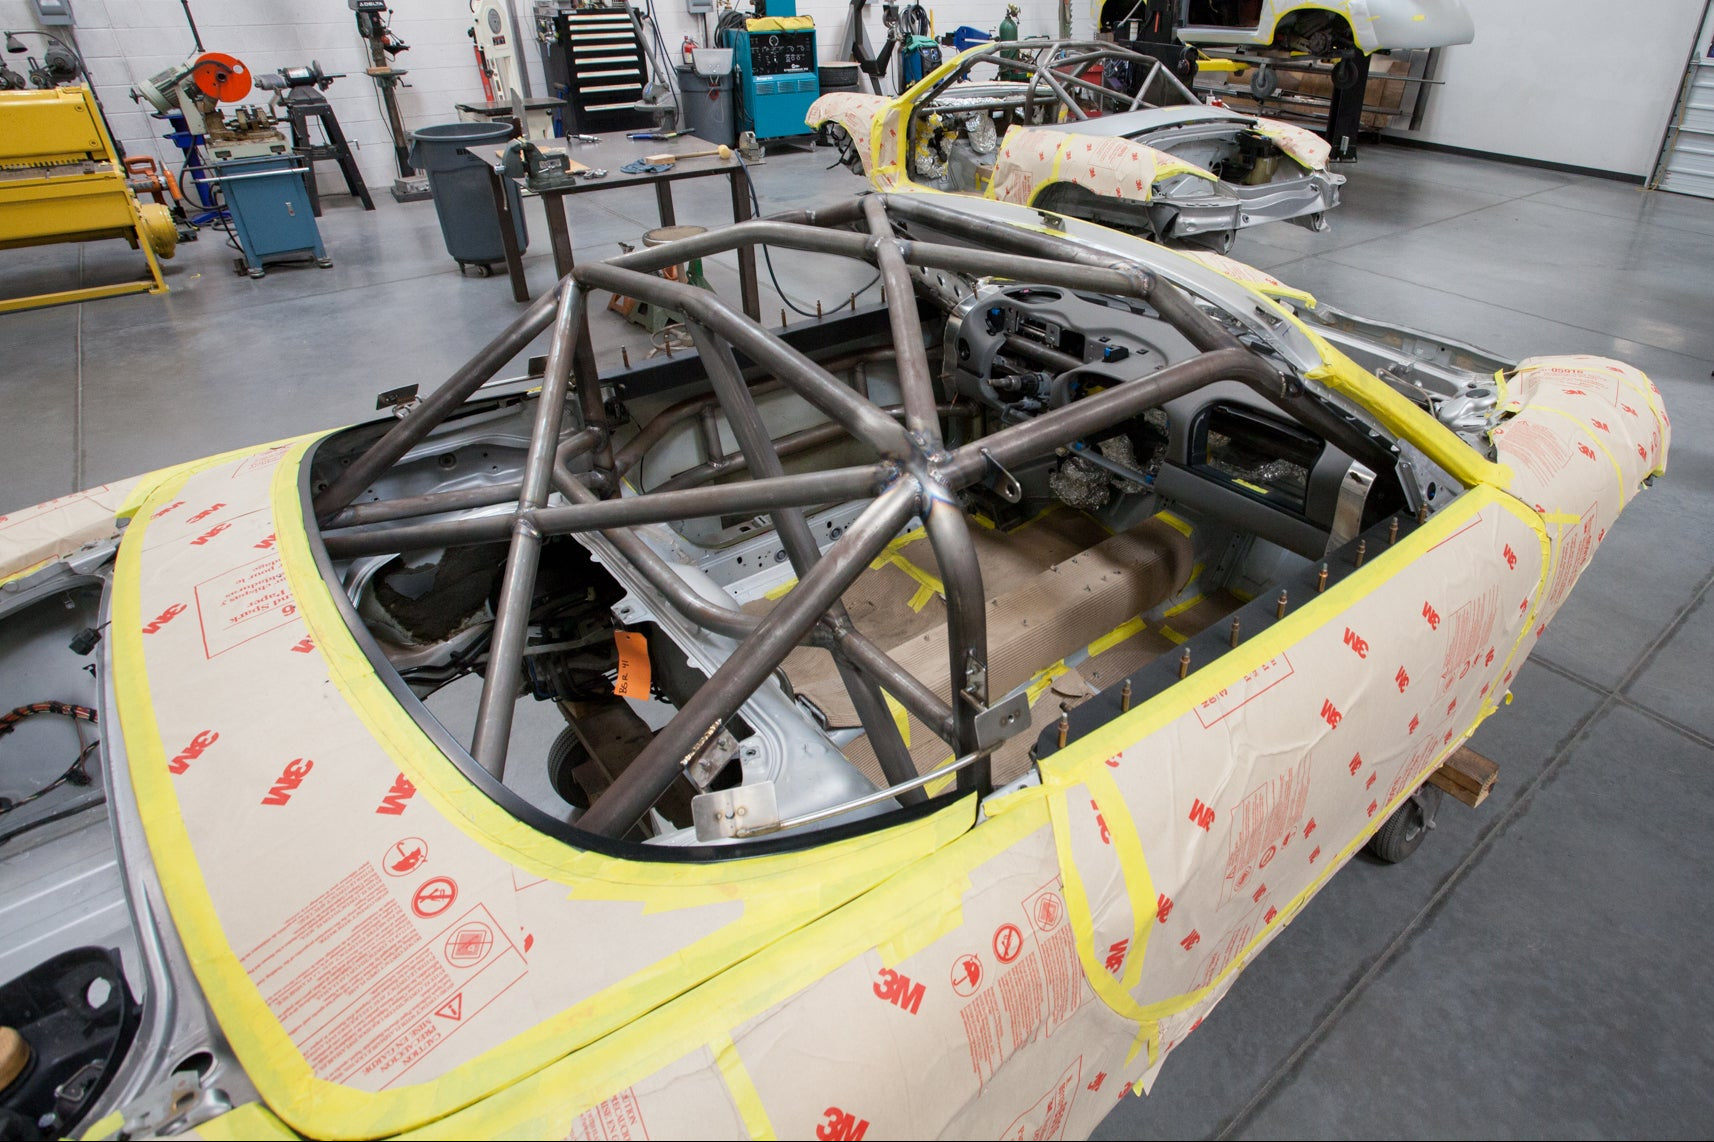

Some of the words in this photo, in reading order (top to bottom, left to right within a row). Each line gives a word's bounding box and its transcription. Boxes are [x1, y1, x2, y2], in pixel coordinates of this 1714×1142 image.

[1592, 420, 1609, 432] 3M
[1578, 442, 1596, 461] 3M
[186, 501, 226, 524] 3M
[190, 523, 231, 546] 3M
[1502, 544, 1518, 571] 3M
[142, 603, 187, 635] 3M
[229, 605, 270, 623] Spark
[1421, 601, 1441, 631] 3M
[1343, 626, 1369, 660] 3M
[1395, 665, 1410, 694] 3M
[1320, 697, 1343, 731] 3M
[167, 729, 220, 775] 3M
[1348, 752, 1363, 776] 3M
[261, 757, 314, 807] 3M
[375, 770, 418, 816] 3M
[1188, 797, 1216, 832] 3M
[1179, 929, 1201, 952] 3M
[1103, 938, 1133, 976] 3M
[872, 963, 927, 1016] 3M
[396, 1035, 408, 1048] EN
[411, 1018, 431, 1037] MISE
[363, 1046, 395, 1075] GARDE
[403, 1032, 441, 1065] CAUTION
[815, 1105, 871, 1142] 3M
